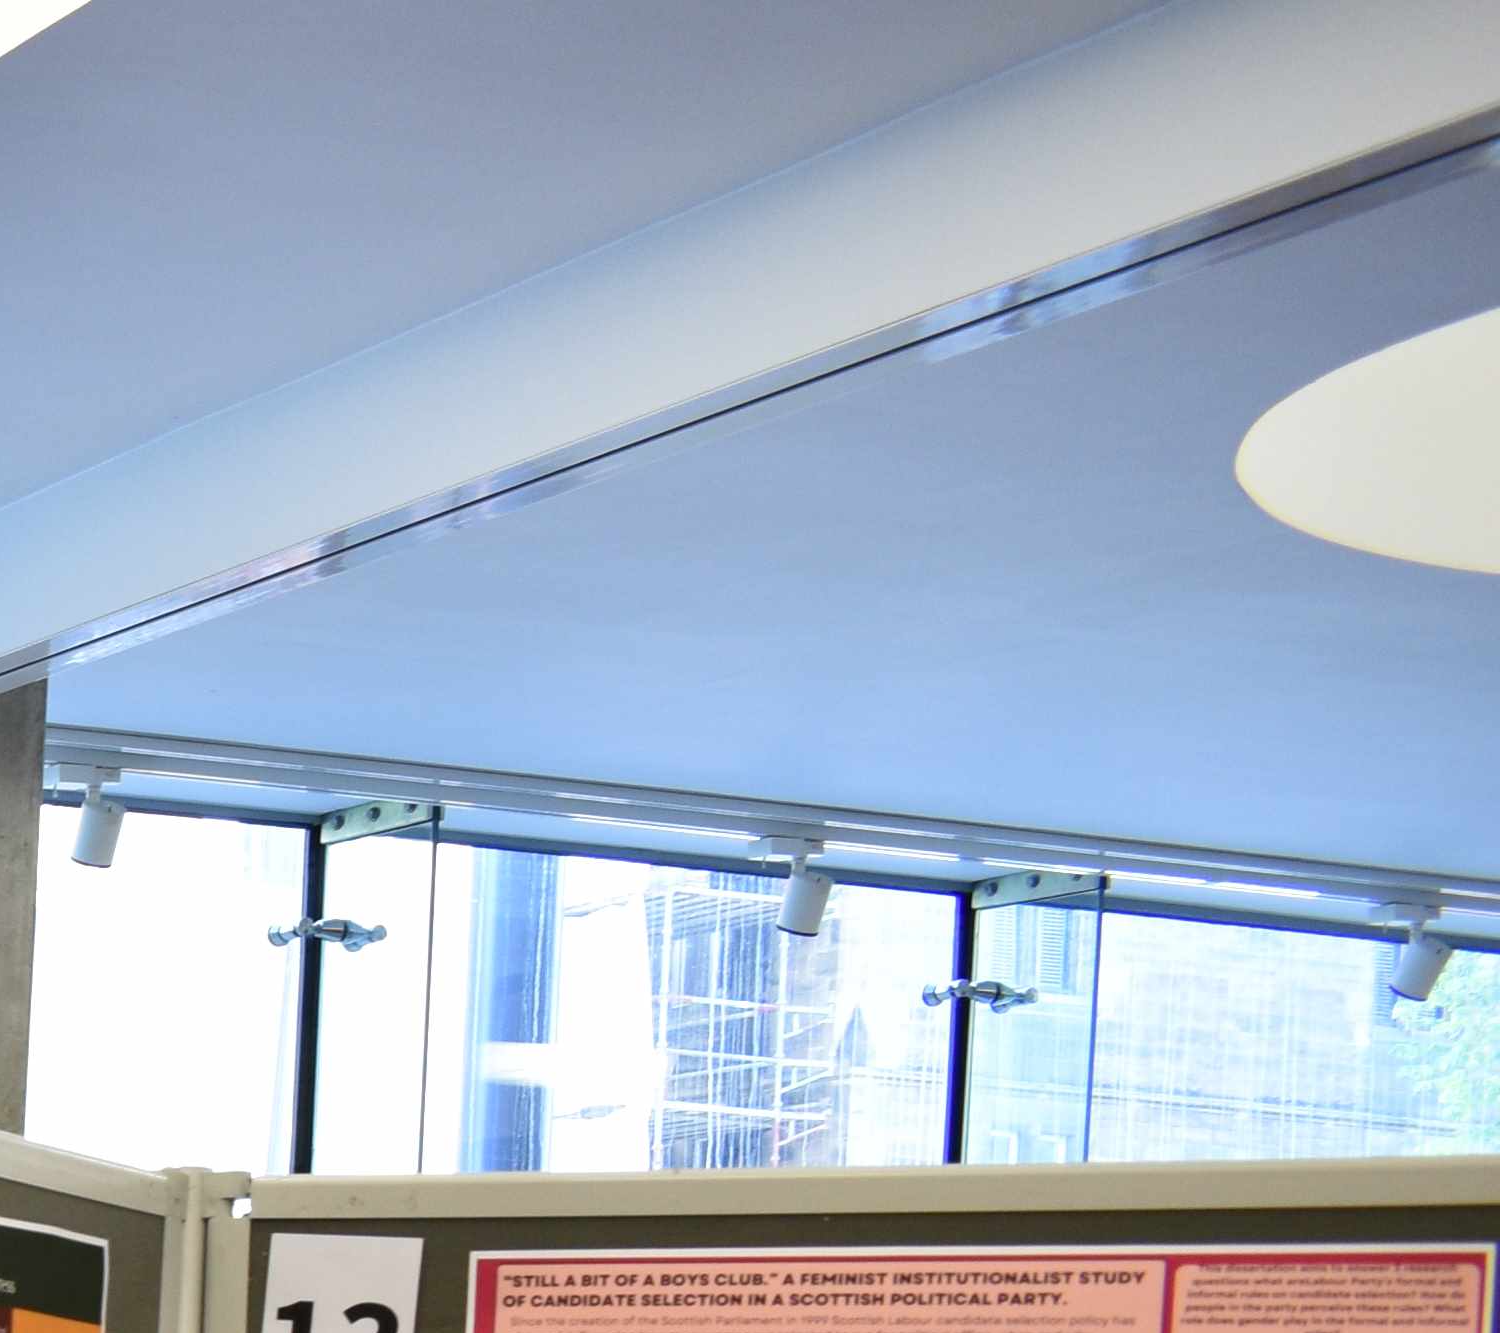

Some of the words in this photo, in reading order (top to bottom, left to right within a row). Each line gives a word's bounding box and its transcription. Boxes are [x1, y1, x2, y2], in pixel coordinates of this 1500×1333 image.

[503, 1274, 559, 1287] "STILL
[563, 1274, 576, 1287] A
[580, 1273, 610, 1287] BIT
[613, 1273, 638, 1286] OF
[642, 1273, 655, 1286] A
[659, 1273, 709, 1286] BOYS
[713, 1272, 778, 1286] CLUB."
[781, 1272, 795, 1285] A
[799, 1272, 888, 1285] FEMINIST
[892, 1271, 1074, 1285] INSTITUTIONALIST
[1078, 1270, 1145, 1284] STUDY
[500, 1294, 526, 1308] OF
[529, 1293, 636, 1307] CANDIDATE
[639, 1293, 744, 1306] SELECTION
[746, 1293, 767, 1306] IN
[770, 1293, 785, 1306] A
[788, 1292, 885, 1306] SCOTTISH
[888, 1292, 992, 1306] POLITICAL
[996, 1291, 1067, 1305] PARTY.
